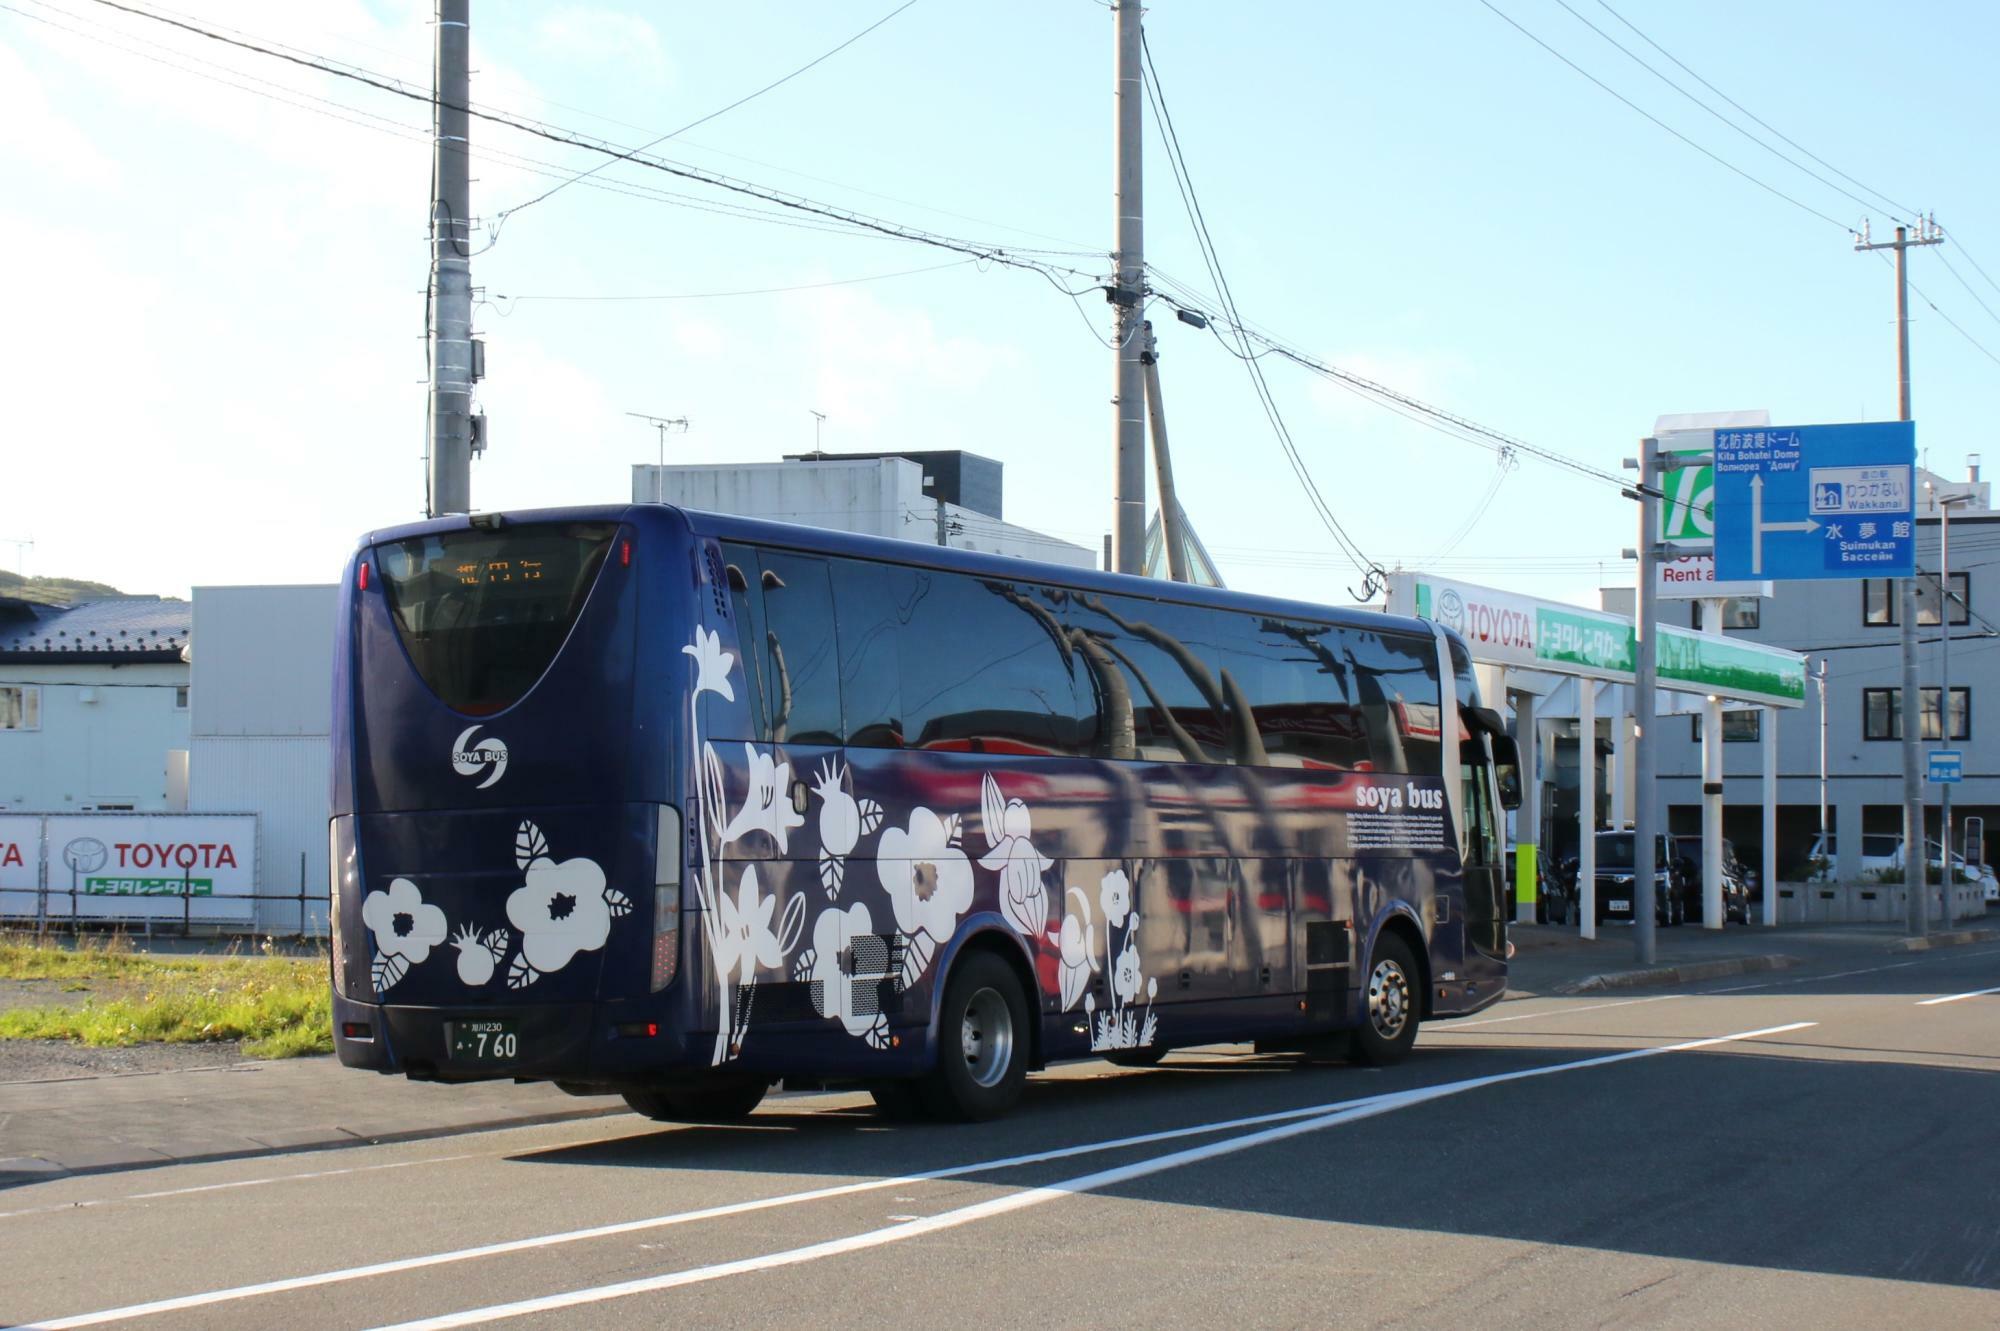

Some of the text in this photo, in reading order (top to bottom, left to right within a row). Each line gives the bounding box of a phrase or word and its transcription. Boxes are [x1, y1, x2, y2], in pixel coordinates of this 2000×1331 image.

[1717, 452, 1735, 461] Kita
[1773, 449, 1799, 459] Dome
[1839, 541, 1896, 551] Suimukan
[1841, 551, 1894, 562] Бассейн
[1663, 567, 1702, 582] Rent
[1467, 602, 1532, 649] TOYOTA
[452, 750, 508, 763] SOYA BUS
[1356, 782, 1443, 813] soya bus
[114, 842, 238, 868] TOYOTA
